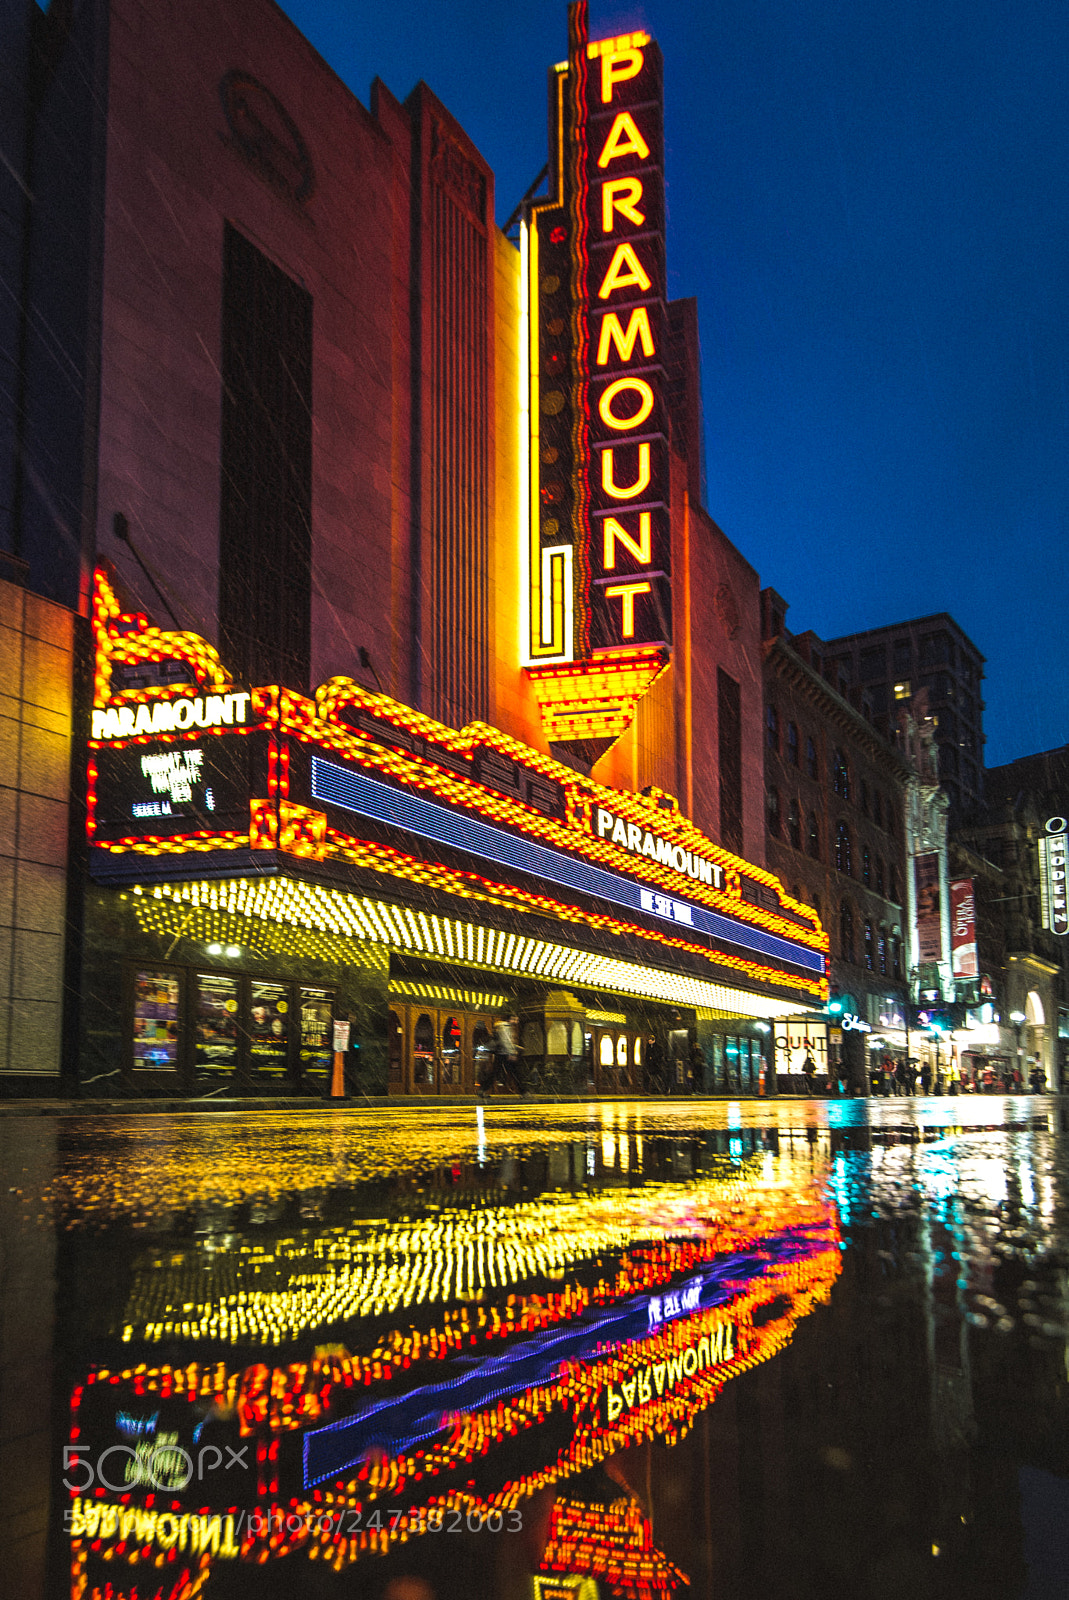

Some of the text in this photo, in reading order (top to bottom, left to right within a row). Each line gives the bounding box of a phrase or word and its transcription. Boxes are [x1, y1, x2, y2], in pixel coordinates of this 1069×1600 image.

[597, 47, 656, 639] PARAMOUNT
[91, 692, 250, 739] PARAMOUNT
[597, 808, 723, 889] PARAMOUNT
